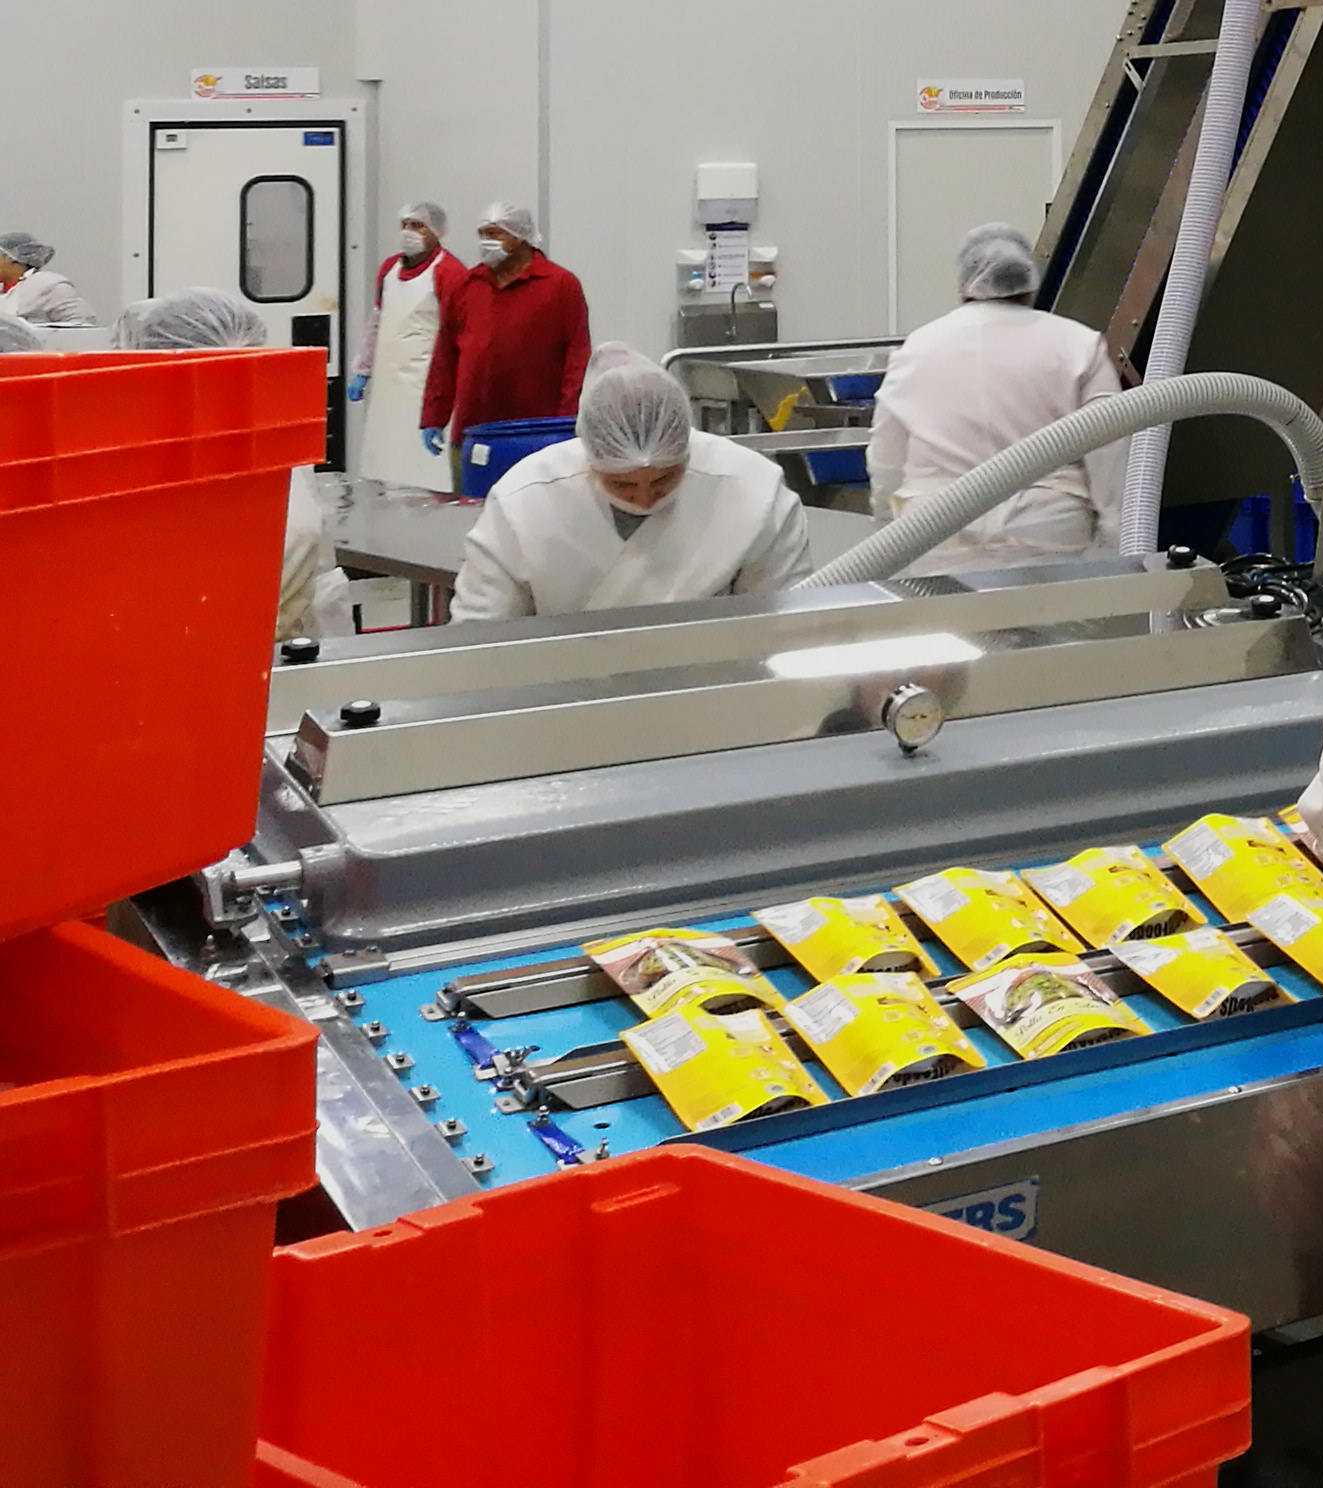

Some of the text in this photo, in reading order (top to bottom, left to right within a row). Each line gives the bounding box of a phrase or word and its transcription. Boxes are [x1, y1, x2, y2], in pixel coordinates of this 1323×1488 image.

[245, 74, 288, 90] Salsas
[949, 88, 1022, 100] Oficina de Producción
